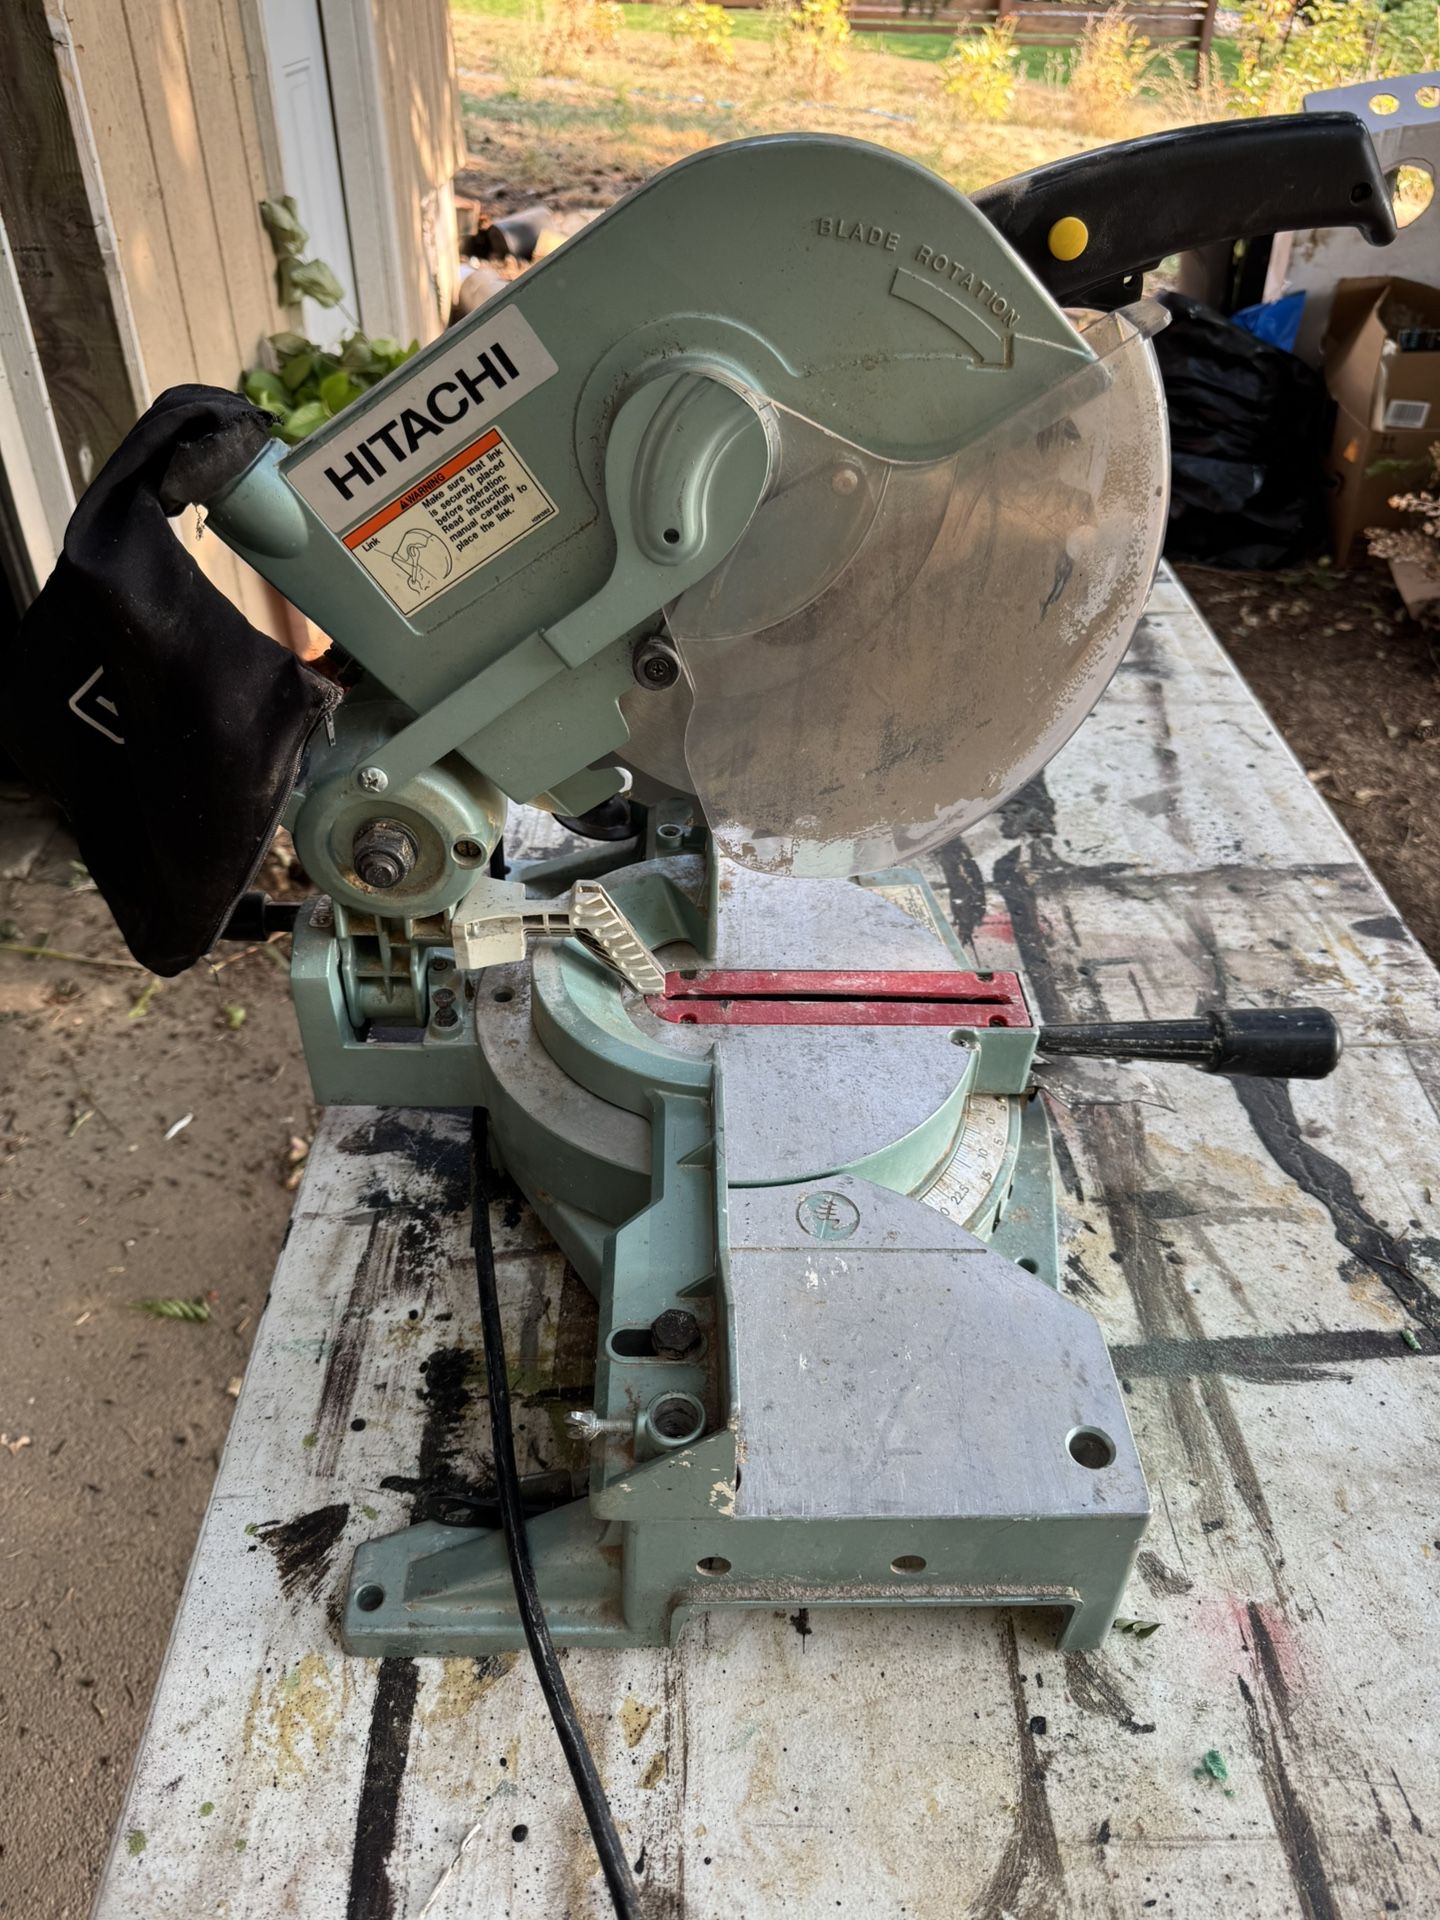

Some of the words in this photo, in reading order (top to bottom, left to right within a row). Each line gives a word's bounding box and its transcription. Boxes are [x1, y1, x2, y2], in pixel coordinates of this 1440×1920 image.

[817, 217, 901, 252] BLADE
[914, 243, 1021, 329] ROTATION
[324, 342, 520, 501] HITACHI
[404, 472, 446, 505] WARNING
[421, 490, 445, 509] Make
[446, 475, 466, 492] sure
[466, 459, 486, 476] that
[486, 447, 504, 462] link
[429, 510, 438, 518] is
[440, 482, 475, 510] securely
[476, 459, 505, 485] placed
[434, 503, 464, 526] before
[465, 474, 507, 505] operation.
[441, 515, 465, 534] Read
[466, 483, 510, 516] instruction
[449, 518, 479, 542] manual
[480, 492, 516, 520] carefully
[517, 484, 527, 494] to
[455, 531, 479, 552] place
[479, 520, 496, 533] the
[496, 508, 515, 522] link.
[361, 537, 381, 552] Link
[994, 1138, 1003, 1146] 5
[951, 1185, 970, 1205] 22.5
